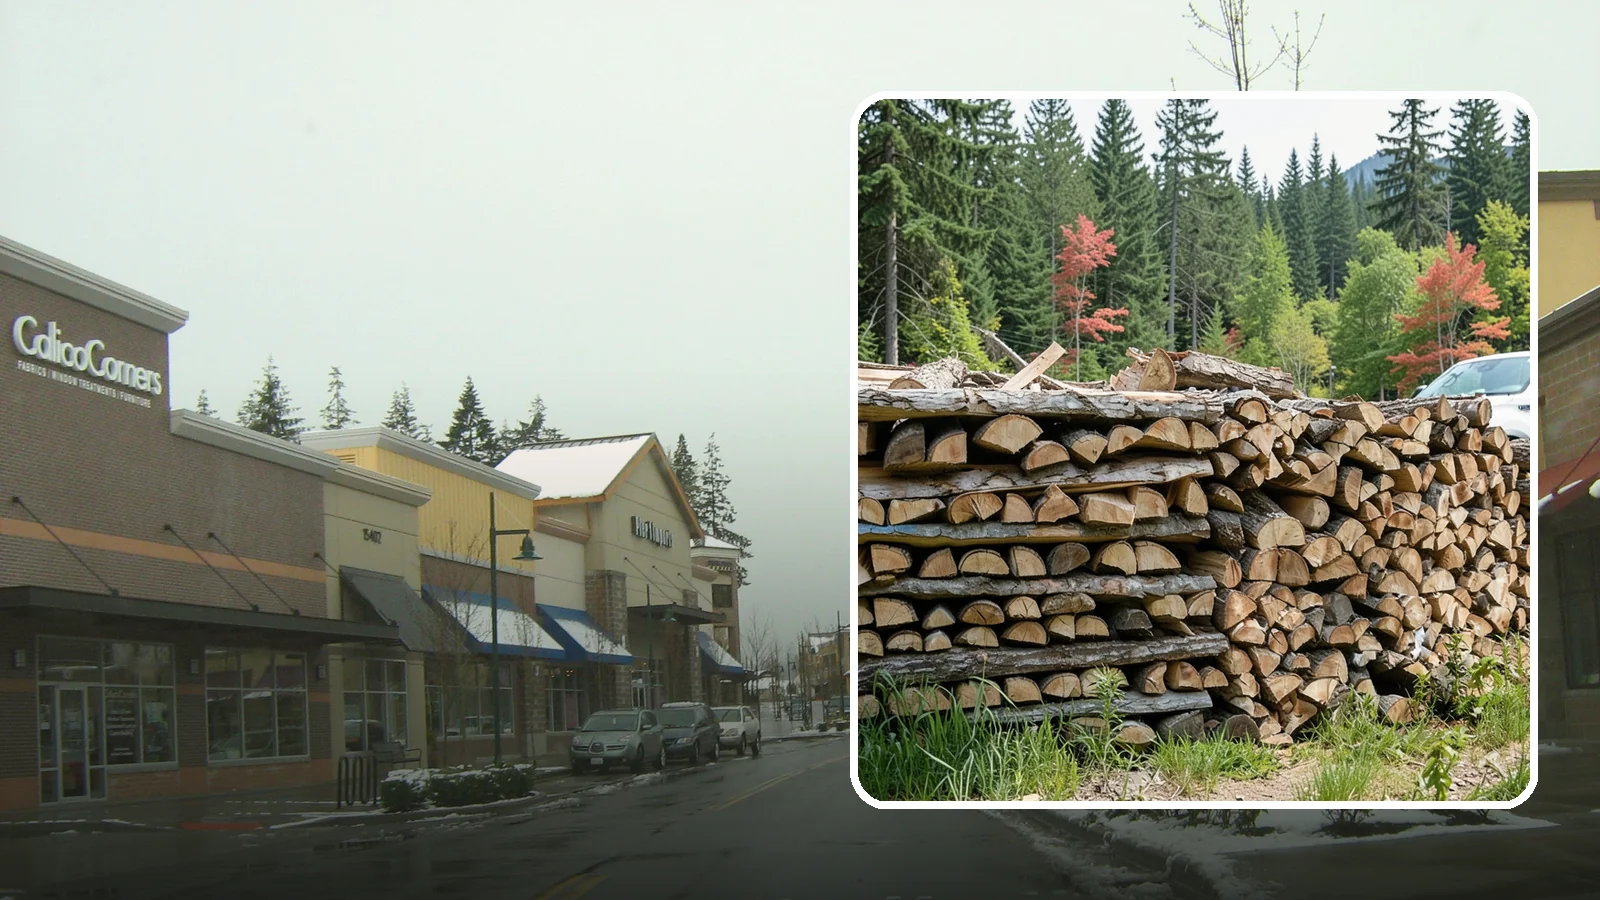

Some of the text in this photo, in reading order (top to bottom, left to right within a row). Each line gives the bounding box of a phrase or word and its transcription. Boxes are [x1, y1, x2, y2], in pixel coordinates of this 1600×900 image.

[17, 360, 151, 409] FABRICS WINDOW TREATMENTS FURNITURE
